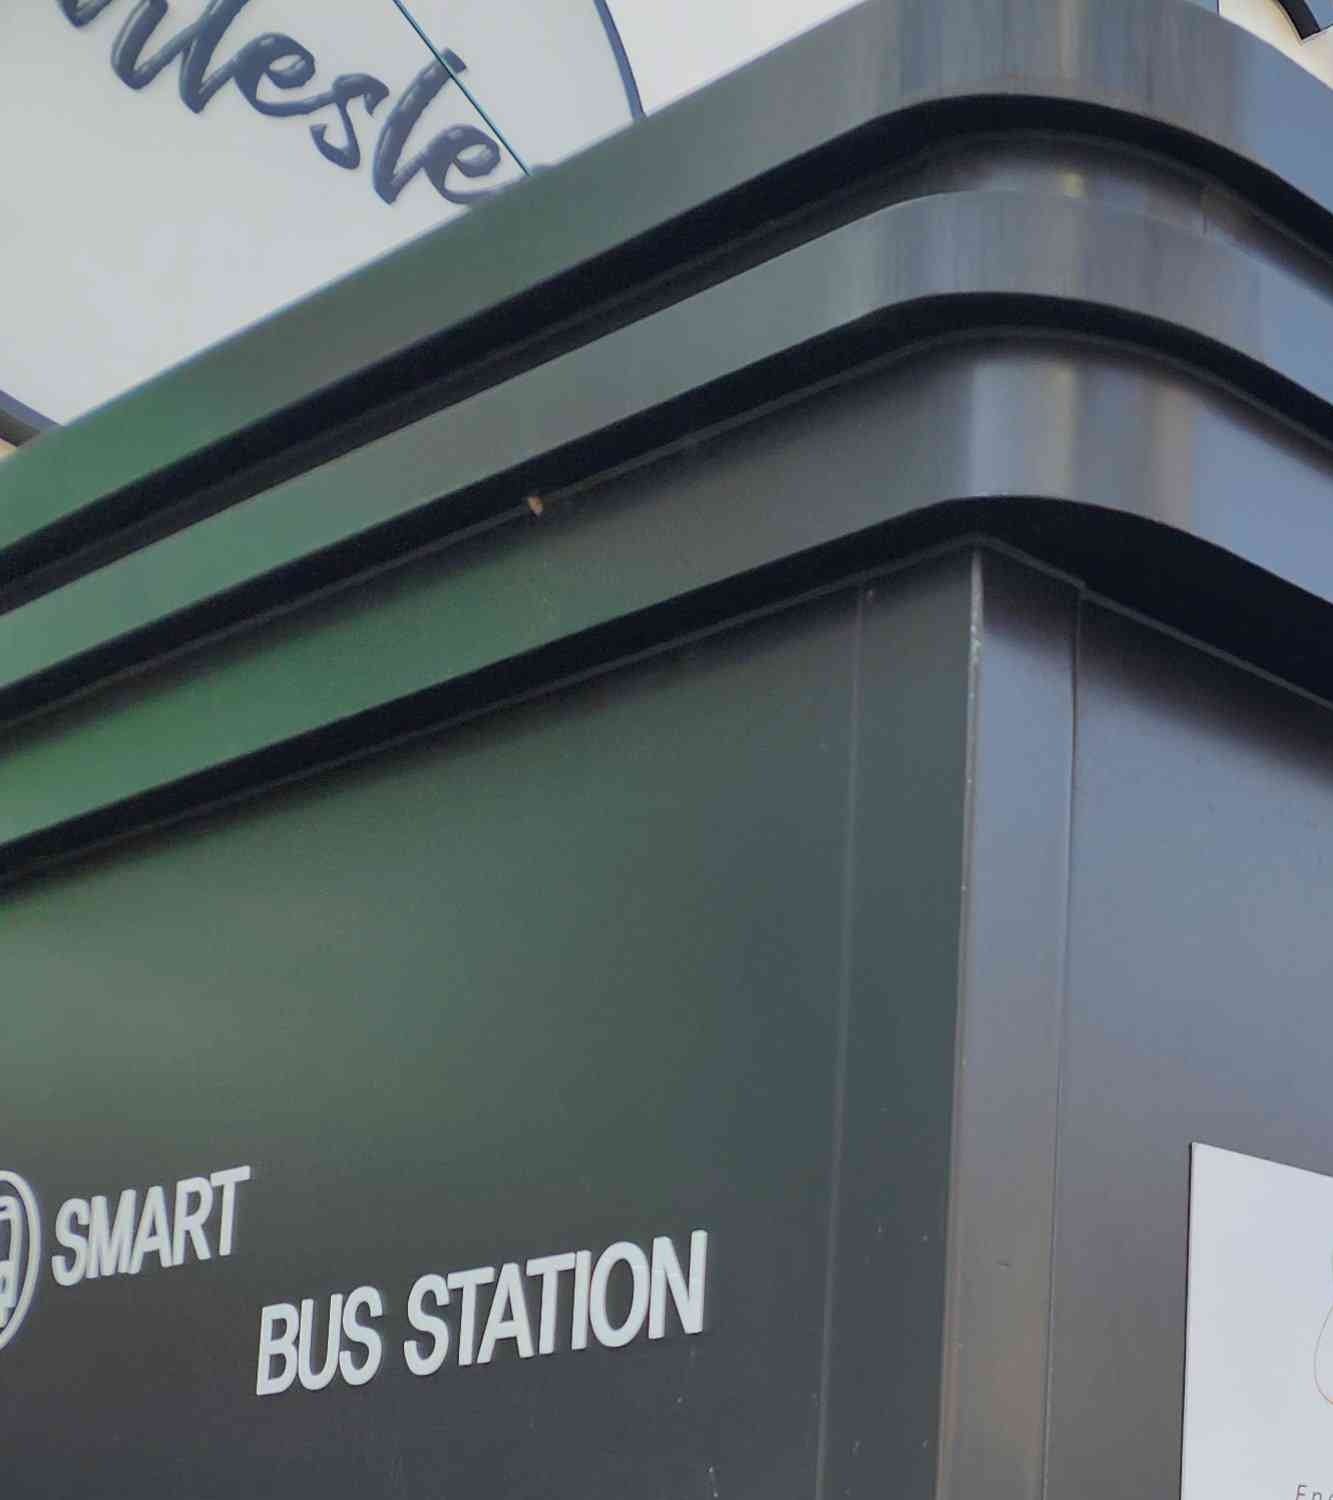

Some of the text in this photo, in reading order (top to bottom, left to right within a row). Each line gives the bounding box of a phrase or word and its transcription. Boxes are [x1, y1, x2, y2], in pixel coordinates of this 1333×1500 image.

[51, 1164, 250, 1286] SMART
[256, 1230, 708, 1396] BUS STATION
